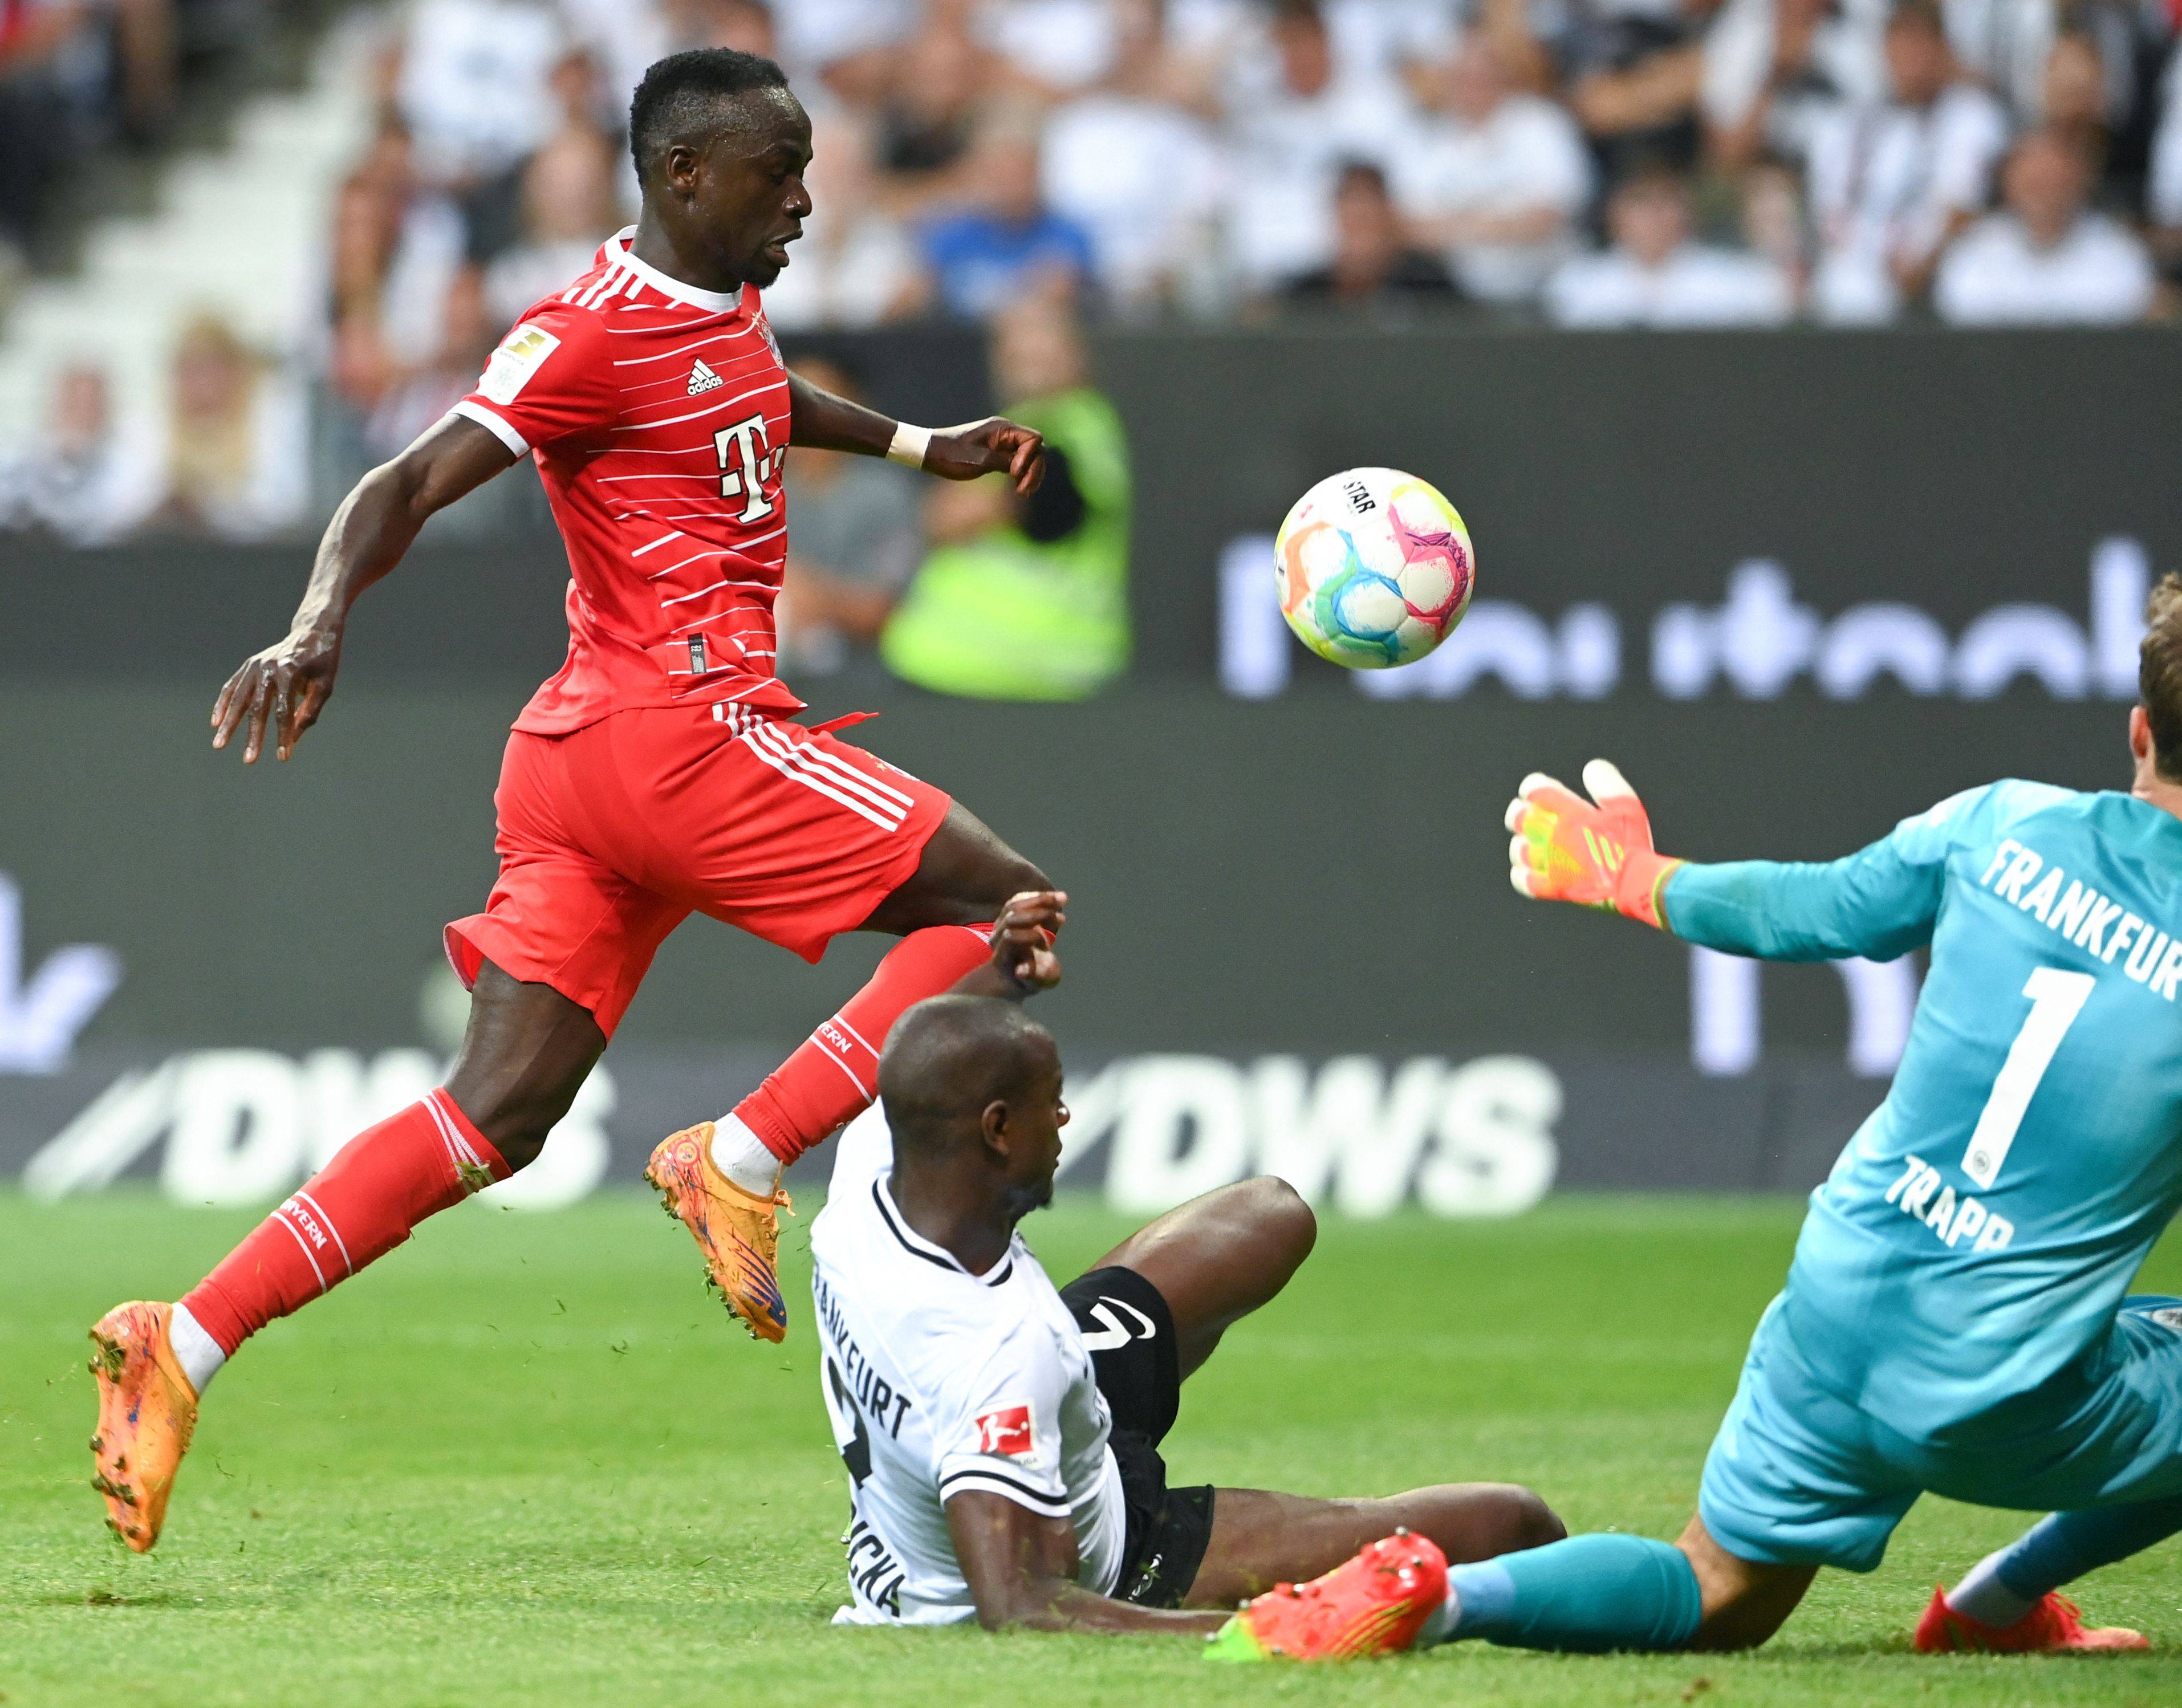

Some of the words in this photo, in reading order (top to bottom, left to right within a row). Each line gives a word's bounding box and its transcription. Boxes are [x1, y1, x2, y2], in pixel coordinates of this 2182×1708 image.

[687, 375, 724, 396] adidas
[1108, 1053, 1563, 1220] DWS
[1961, 966, 2096, 1190] 1
[1885, 1154, 2015, 1252] TRAPP
